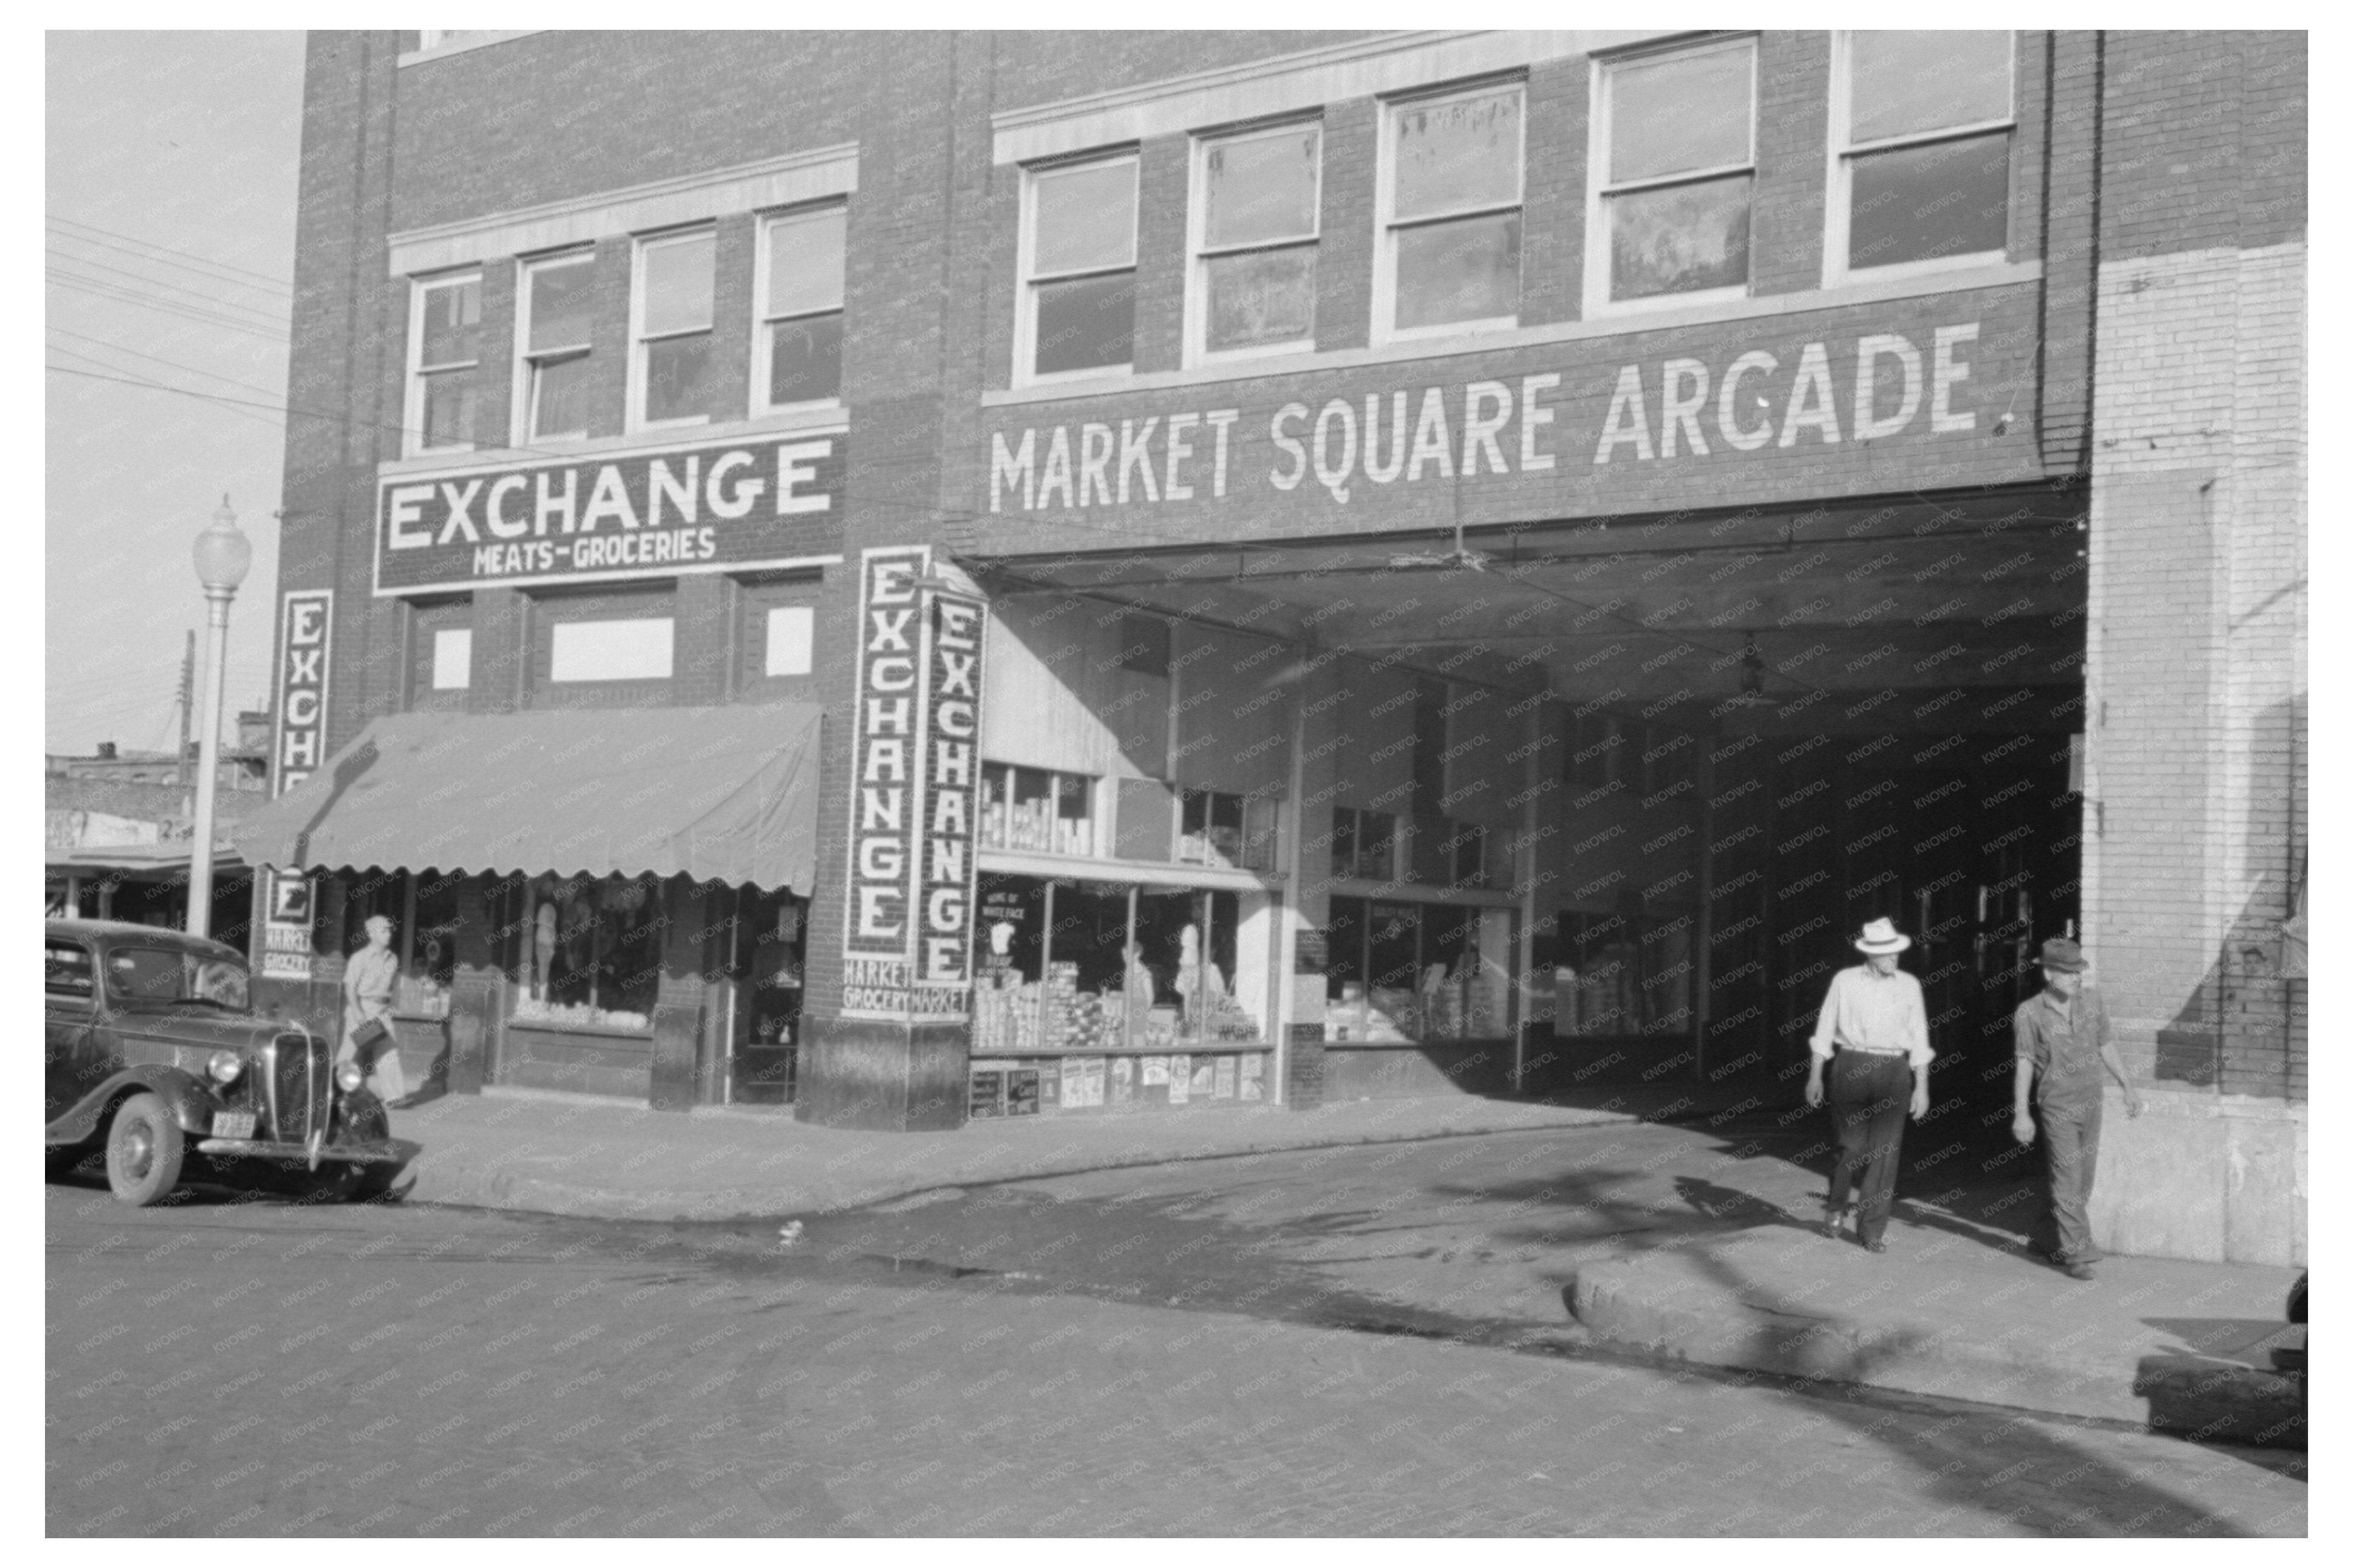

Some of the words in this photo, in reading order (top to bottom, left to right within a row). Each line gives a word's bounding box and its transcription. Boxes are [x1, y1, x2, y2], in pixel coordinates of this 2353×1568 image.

[990, 409, 1239, 513] MARKET
[1269, 373, 1561, 503] SQUARE
[1593, 323, 1980, 463] ARCADE
[389, 441, 832, 549] EXCHANGE
[858, 562, 915, 937] EXCHANGE
[927, 603, 976, 980] EXCHANGE
[844, 959, 912, 988] MARKET
[844, 986, 910, 1011] GROCERY
[912, 988, 970, 1014] MARKET
